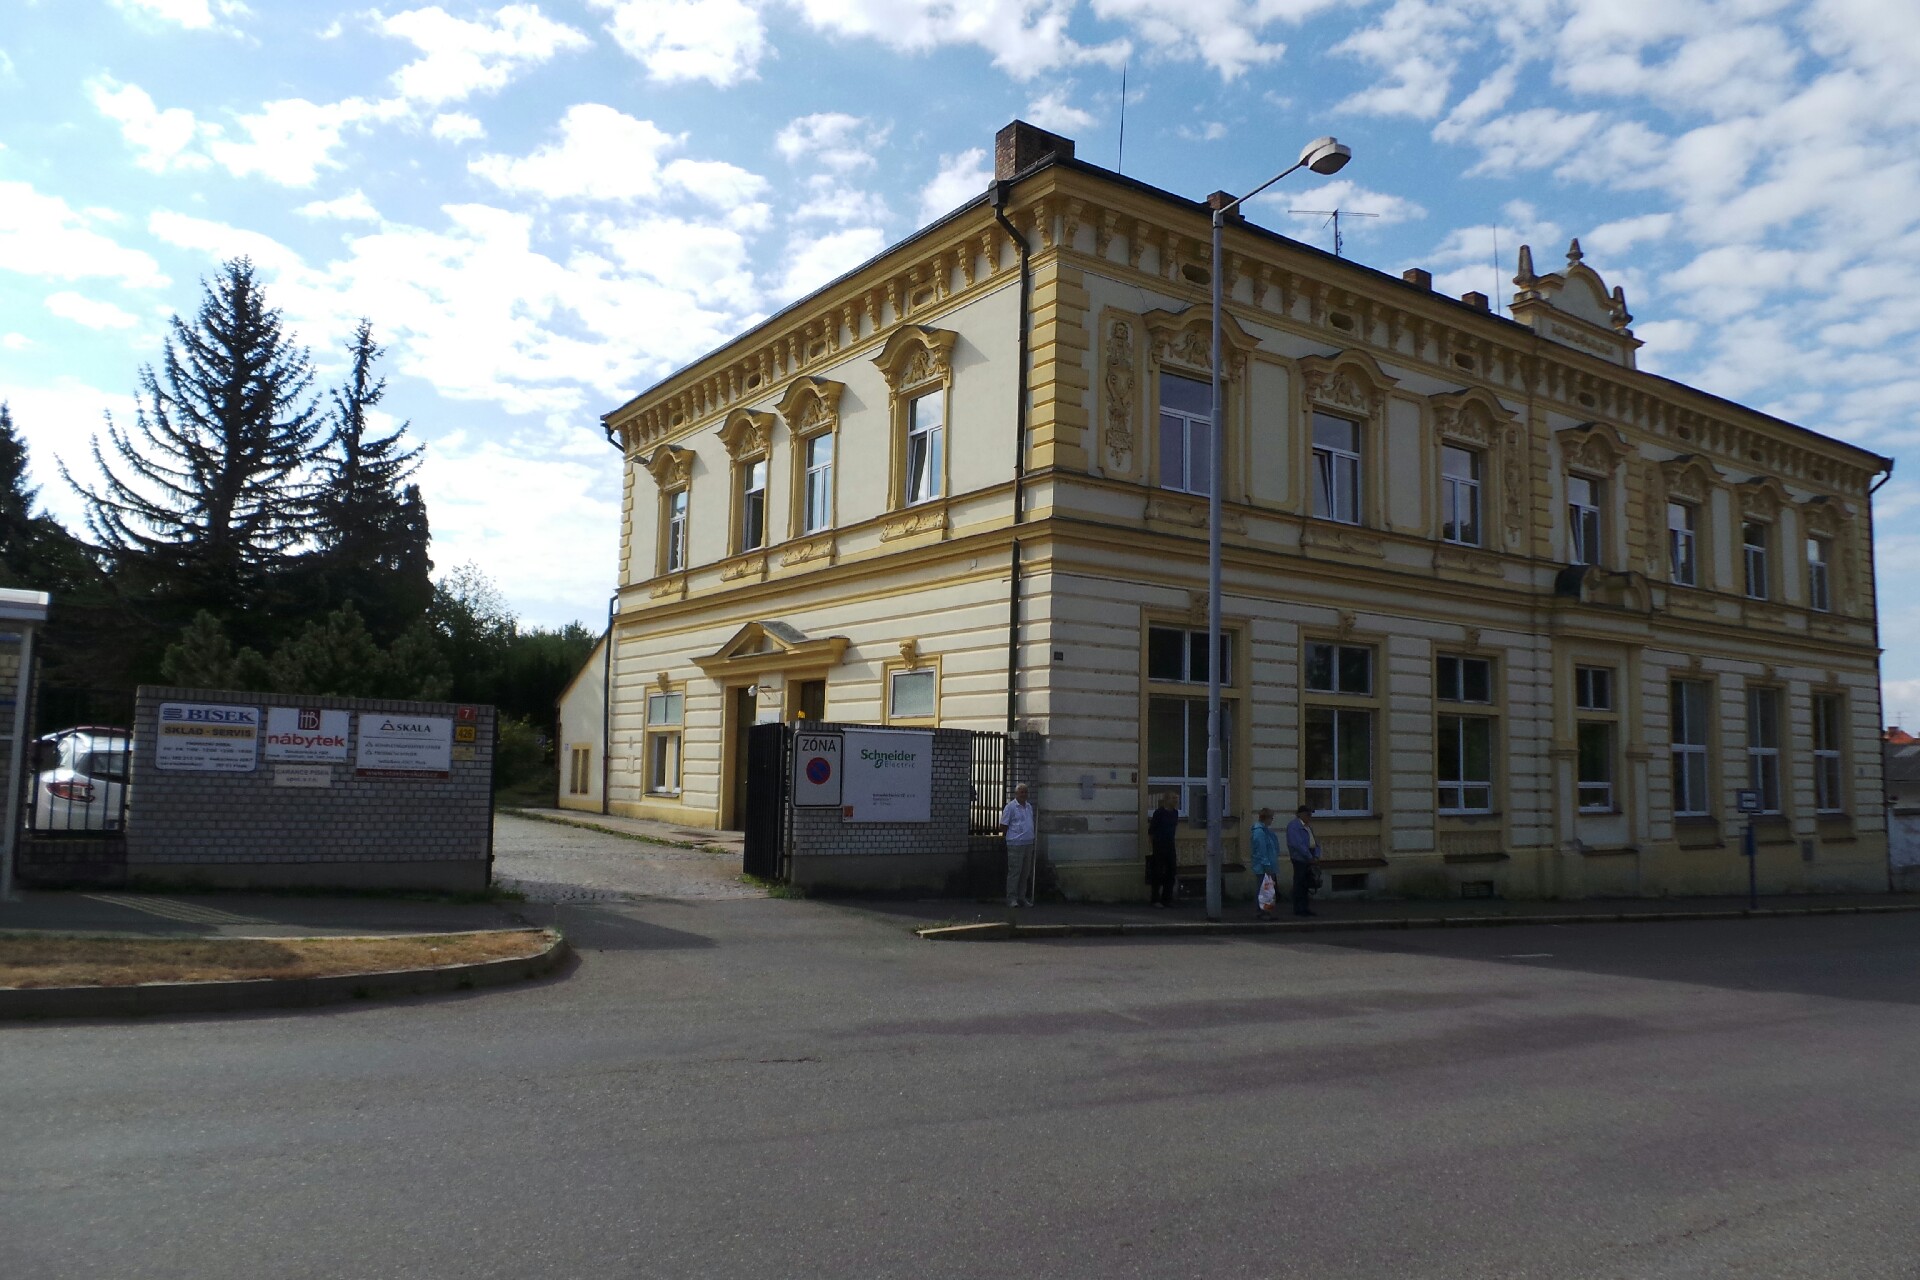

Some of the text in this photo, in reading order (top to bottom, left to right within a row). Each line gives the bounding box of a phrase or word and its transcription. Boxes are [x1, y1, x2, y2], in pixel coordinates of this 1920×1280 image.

[464, 709, 470, 719] 7
[164, 726, 204, 736] SKLAD
[212, 728, 251, 738] SERVIS
[396, 723, 431, 733] SKALA
[267, 732, 345, 748] nábytek
[802, 737, 836, 752] ZÓNA
[860, 749, 916, 761] Schneider
